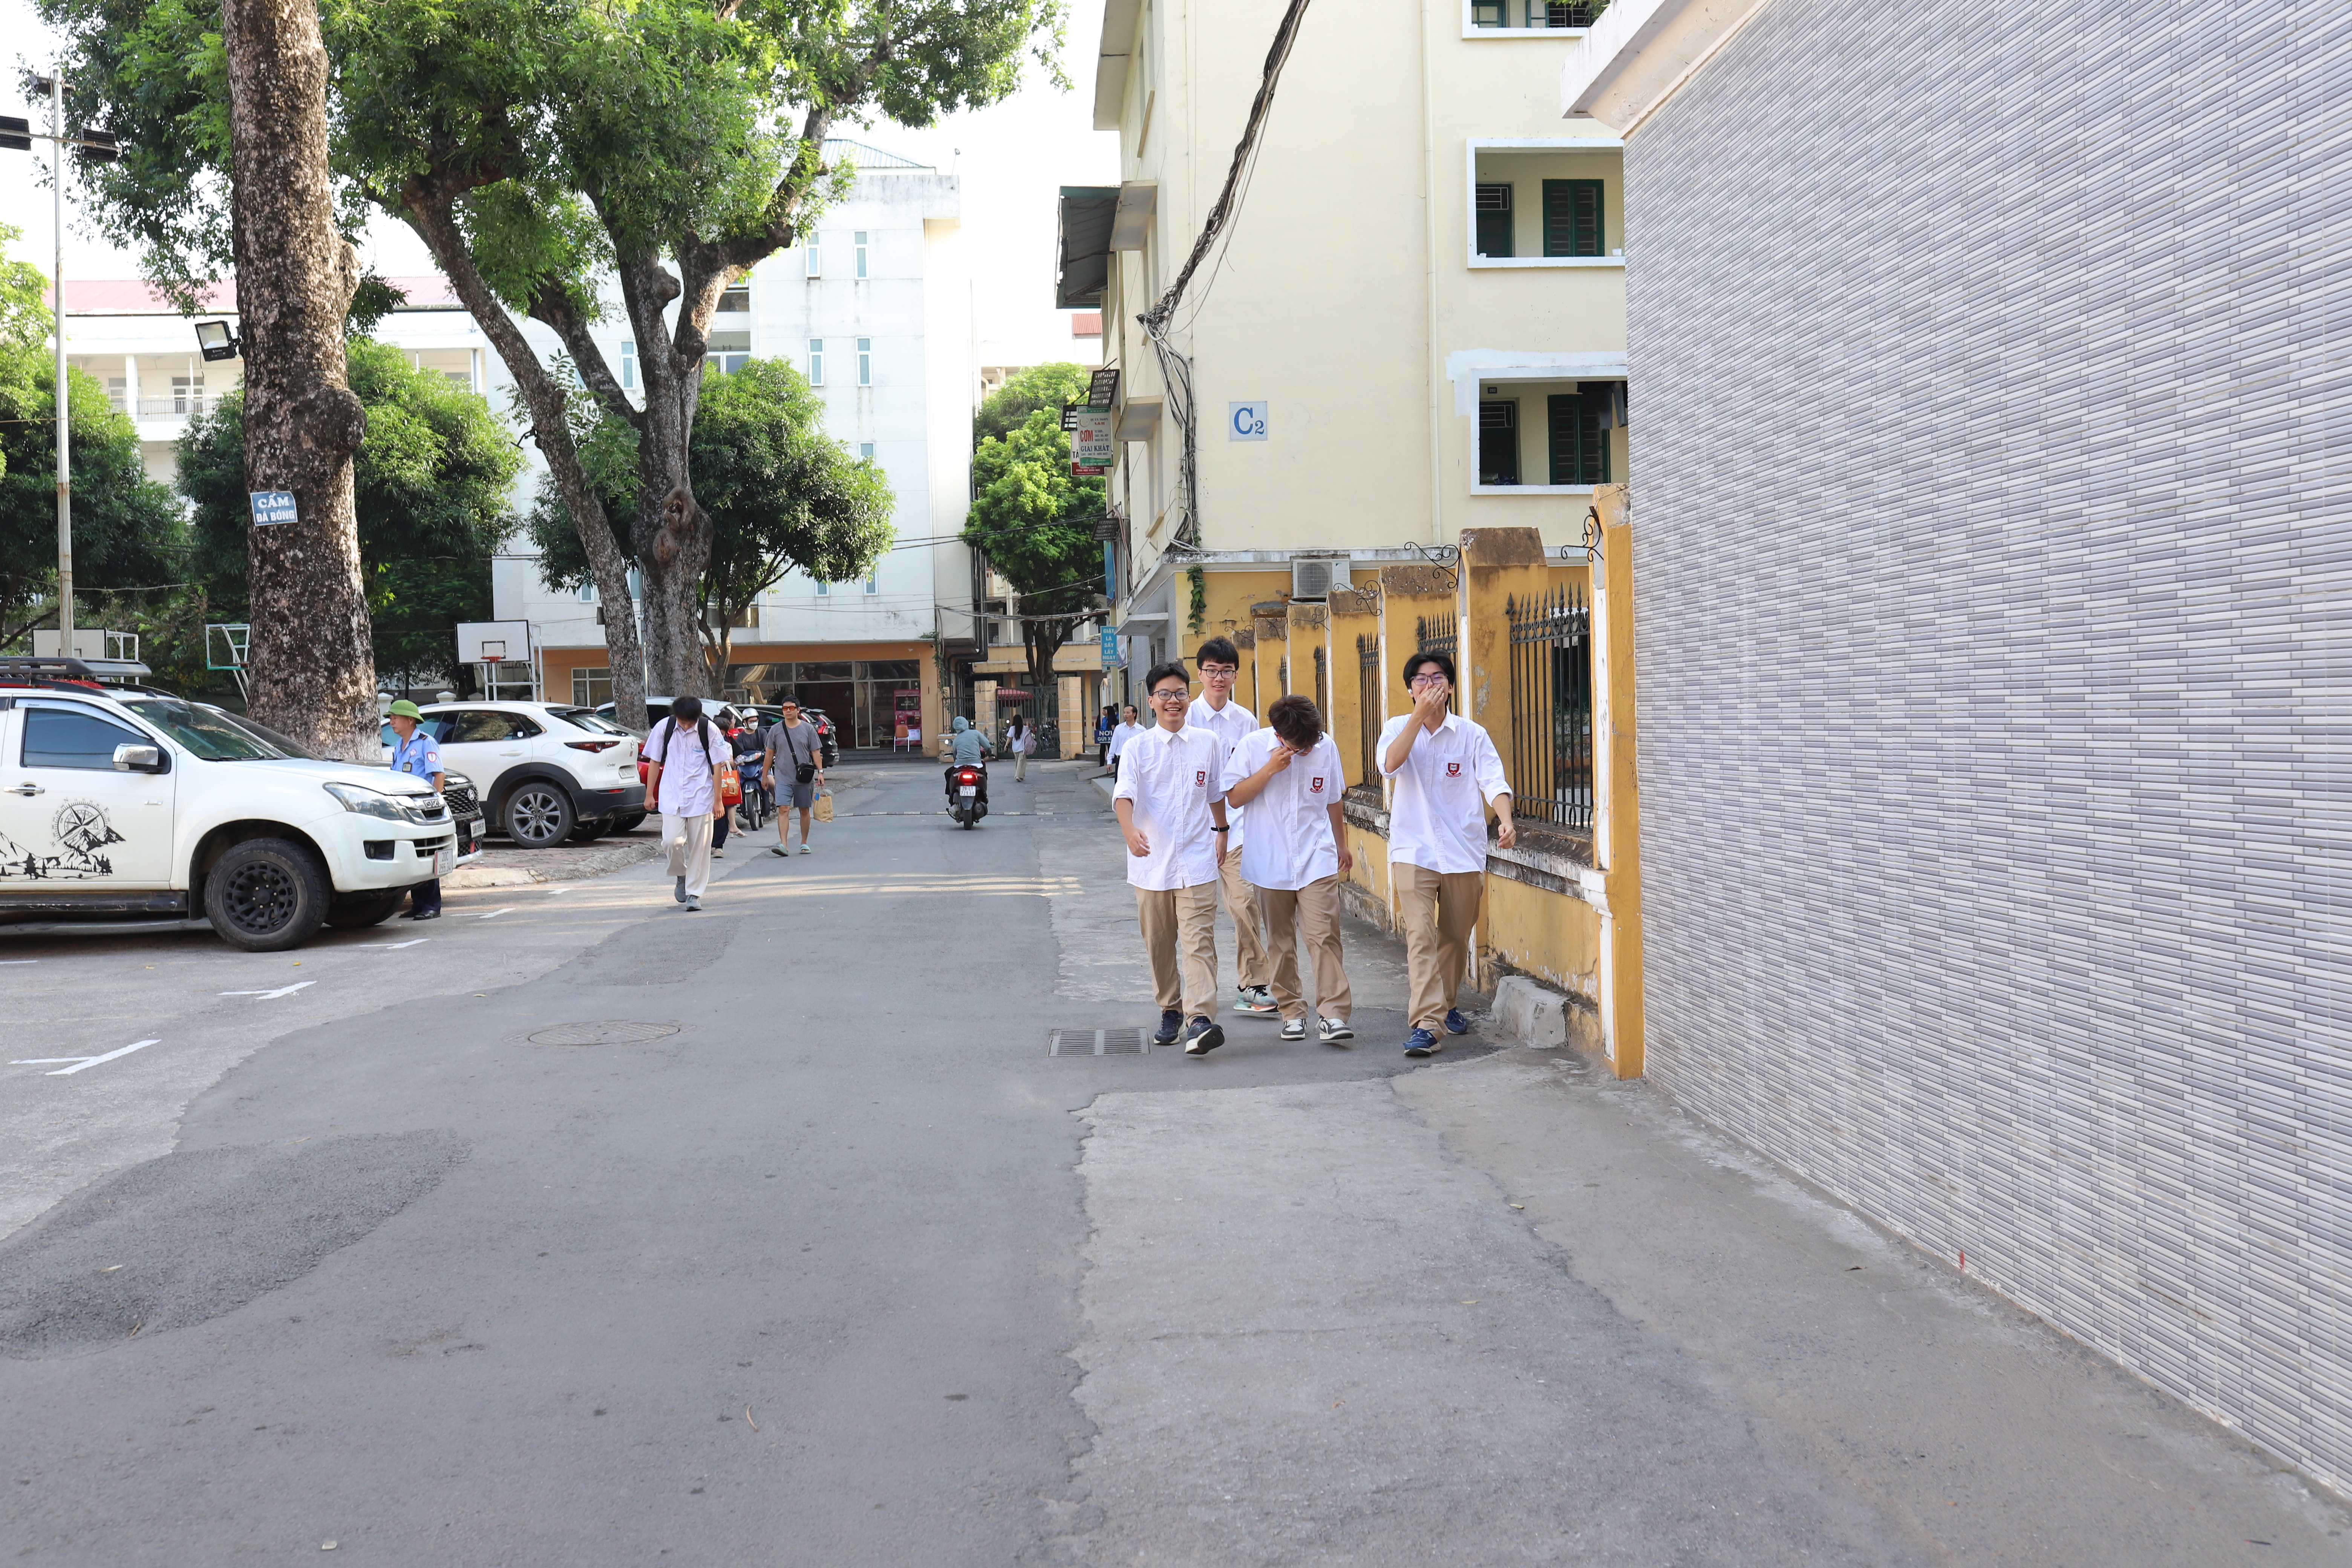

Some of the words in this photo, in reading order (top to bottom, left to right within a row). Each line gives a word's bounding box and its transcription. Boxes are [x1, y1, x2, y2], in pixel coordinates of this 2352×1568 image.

[1080, 429, 1093, 442] CƠM
[258, 493, 289, 508] CẤM
[256, 511, 269, 522] ĐÁ
[270, 510, 295, 521] BÓNG
